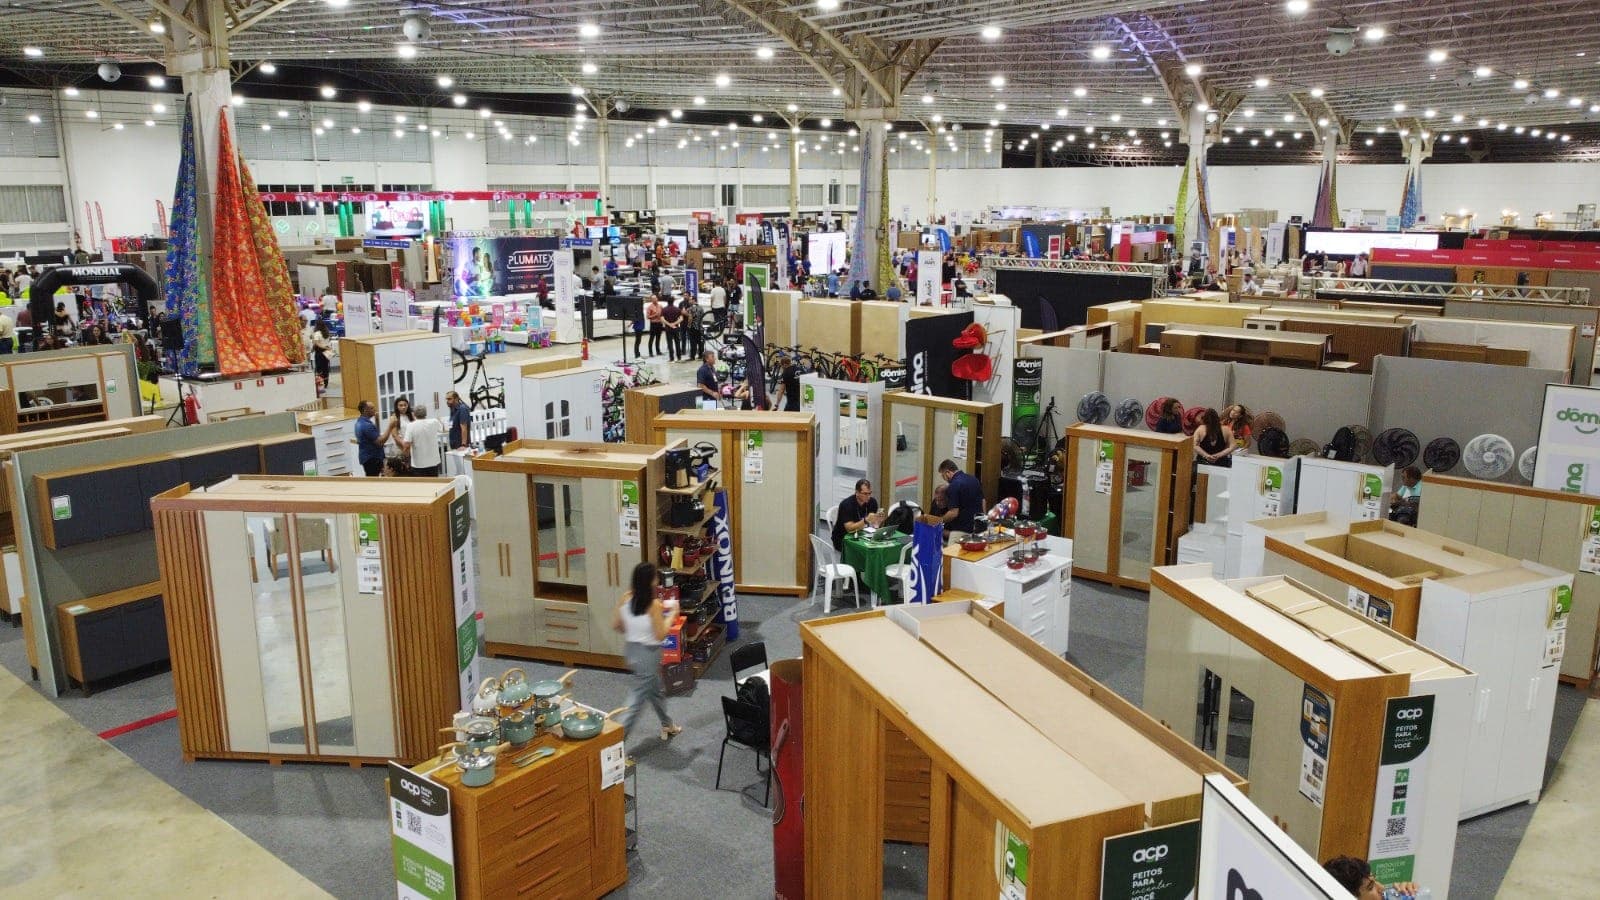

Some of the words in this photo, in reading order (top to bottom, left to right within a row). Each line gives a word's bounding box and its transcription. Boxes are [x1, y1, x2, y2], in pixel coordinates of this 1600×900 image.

[71, 266, 122, 276] MONDIAL
[714, 513, 737, 621] BRINOX
[1396, 708, 1423, 720] acp
[400, 778, 421, 796] acp
[1132, 844, 1169, 863] acp
[1132, 867, 1163, 881] FEITOS
[1132, 878, 1155, 889] PARA
